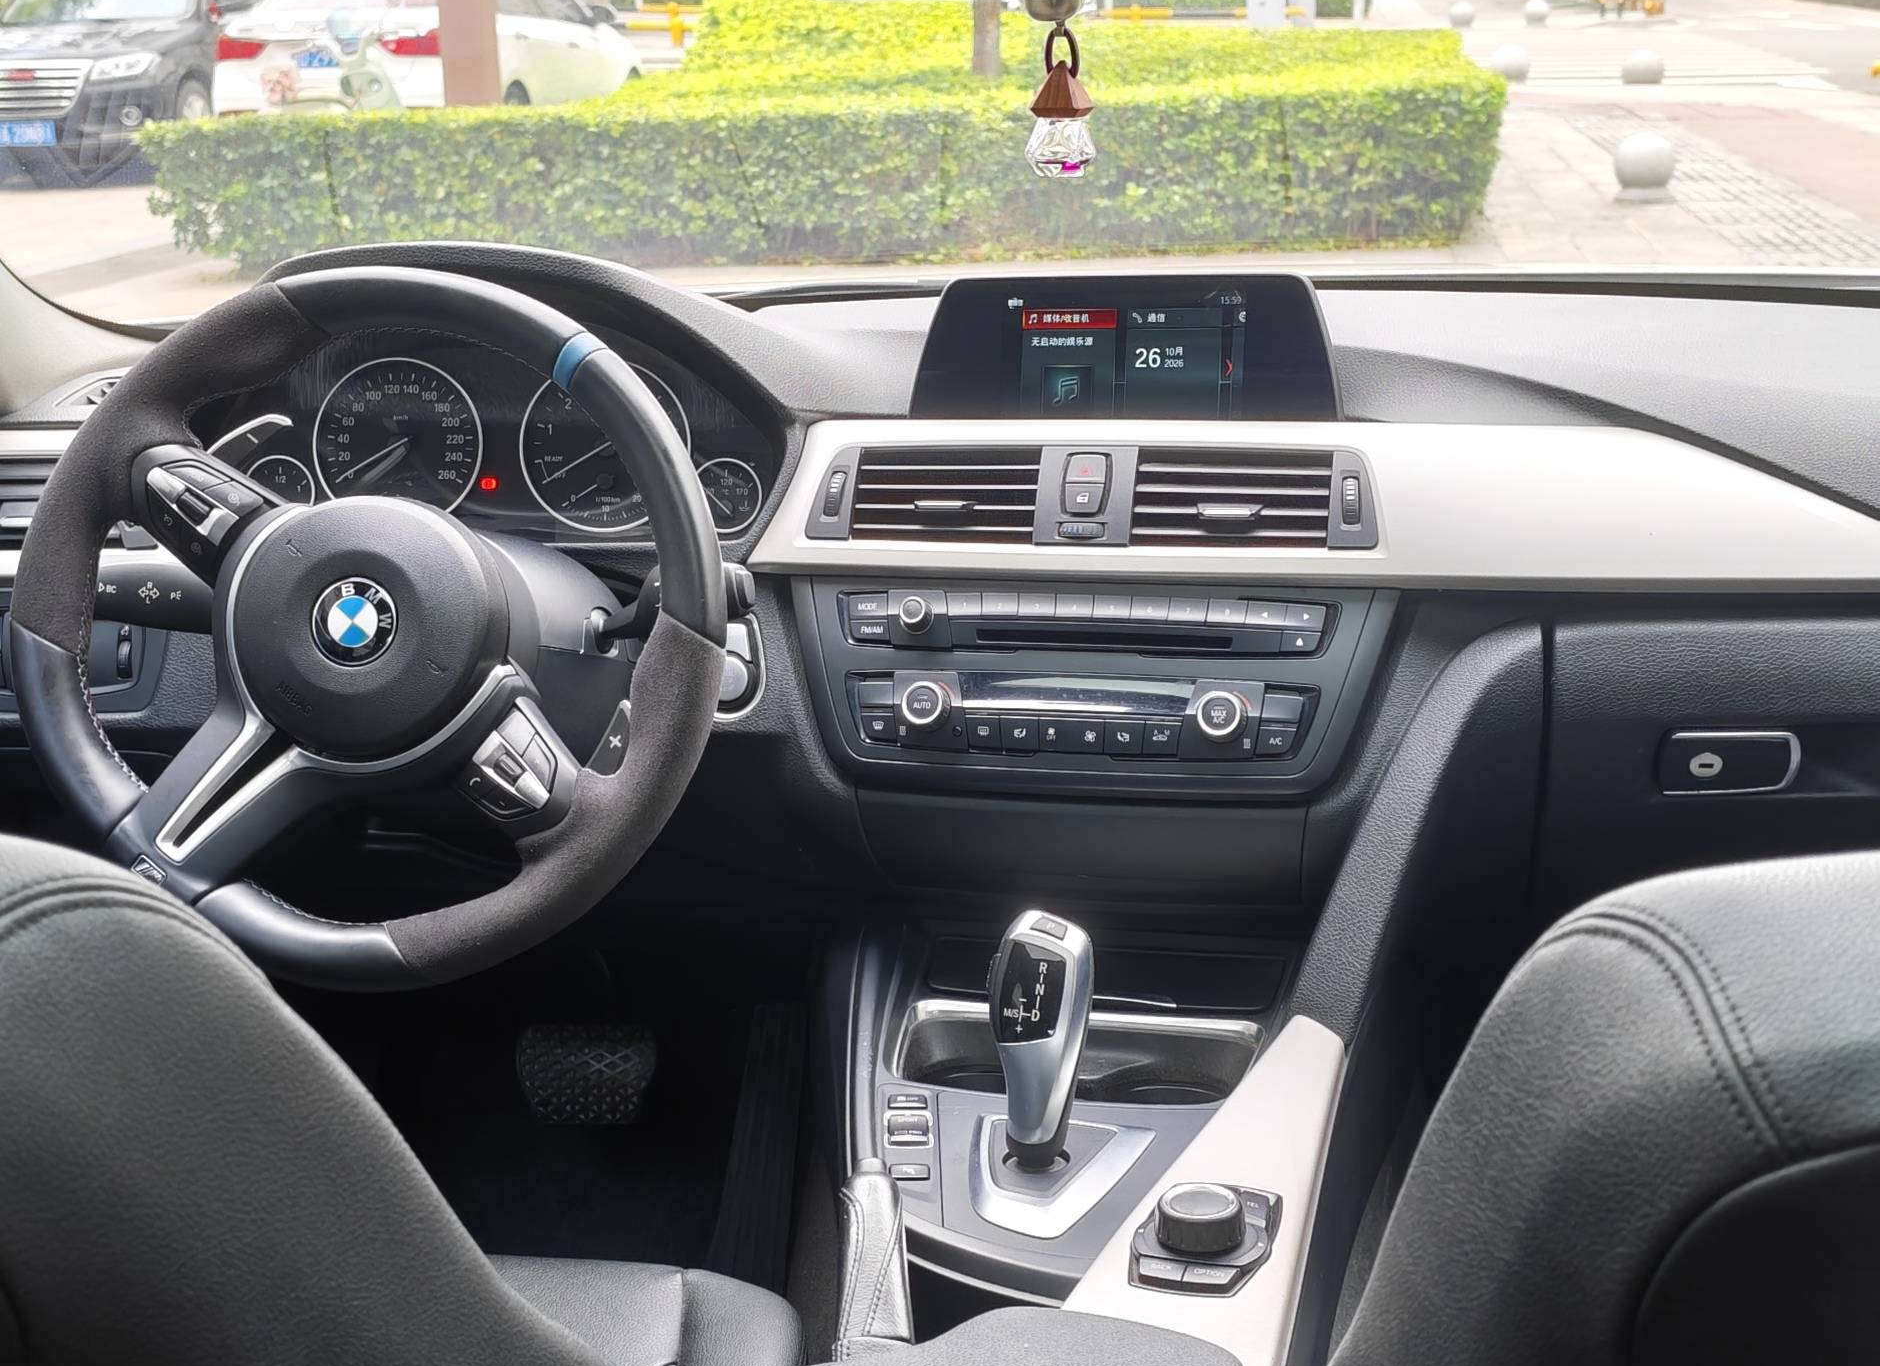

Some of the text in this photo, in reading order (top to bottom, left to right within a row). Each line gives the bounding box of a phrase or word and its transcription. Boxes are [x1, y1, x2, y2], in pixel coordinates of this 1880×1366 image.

[1147, 313, 1166, 323] 通信
[1166, 346, 1183, 356] 10月
[1135, 348, 1161, 368] 26
[384, 384, 400, 393] 120
[402, 384, 419, 393] 140
[365, 391, 381, 400] 100
[421, 391, 437, 400] 160
[352, 403, 365, 412] 80
[434, 403, 450, 412] 180
[342, 417, 354, 426] 60
[441, 418, 460, 427] 200
[337, 434, 350, 443] 40
[446, 435, 464, 444] 220
[338, 452, 350, 461] 20
[444, 452, 463, 462] 240
[275, 475, 286, 483] 1/2
[437, 470, 456, 480] 260
[106, 584, 117, 594] BC
[341, 582, 392, 629] BMW
[858, 602, 878, 611] MODE
[860, 625, 884, 635] FM/AM
[912, 701, 931, 709] AUTO
[1211, 709, 1227, 717] MAX
[1213, 716, 1225, 724] A/C
[1269, 737, 1283, 746] A/C
[1039, 961, 1048, 974] R
[1035, 983, 1045, 996] N
[1003, 1007, 1019, 1018] M/S
[1031, 1009, 1041, 1022] D
[1194, 1268, 1225, 1277] OPTION
